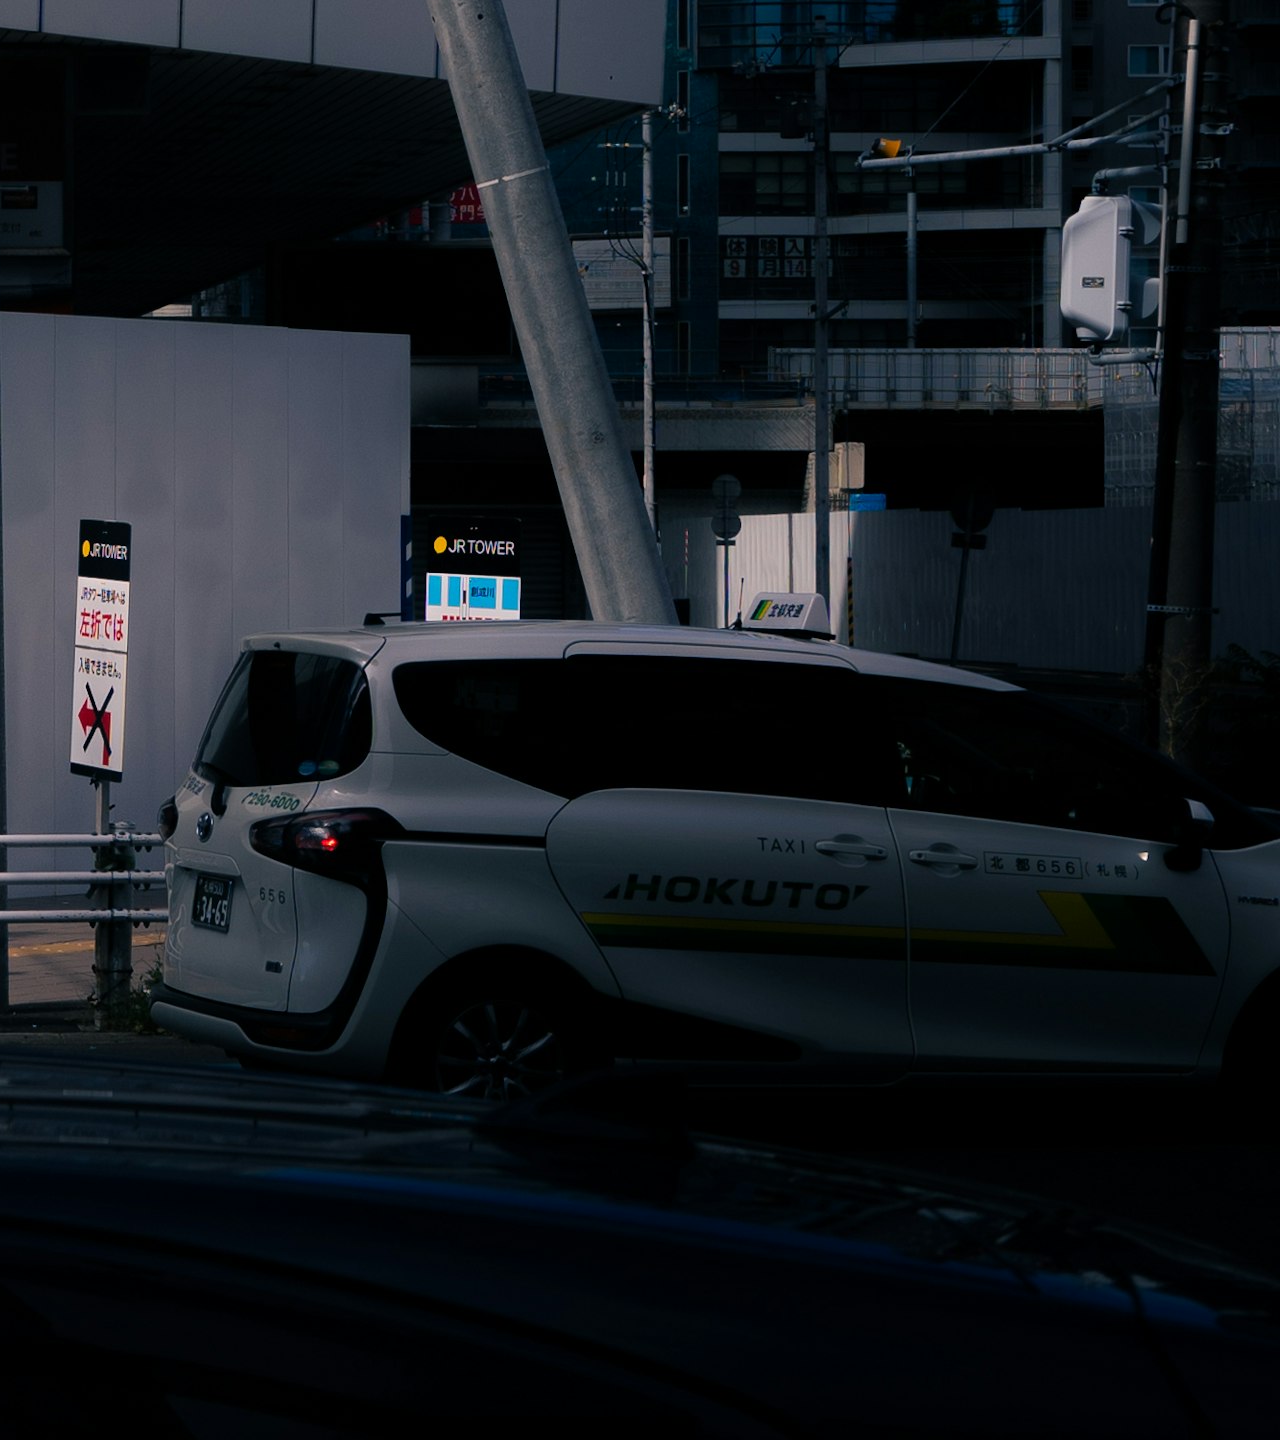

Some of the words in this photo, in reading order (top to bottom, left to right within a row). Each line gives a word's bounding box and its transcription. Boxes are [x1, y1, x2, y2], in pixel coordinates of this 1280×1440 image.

[90, 543, 101, 558] JR
[101, 543, 128, 560] TOWER
[448, 539, 466, 554] JR
[467, 540, 515, 556] TOWER
[79, 608, 124, 641] 左折では
[757, 837, 806, 854] TAXI
[259, 887, 286, 904] 656
[624, 873, 851, 910] HOKUTO
